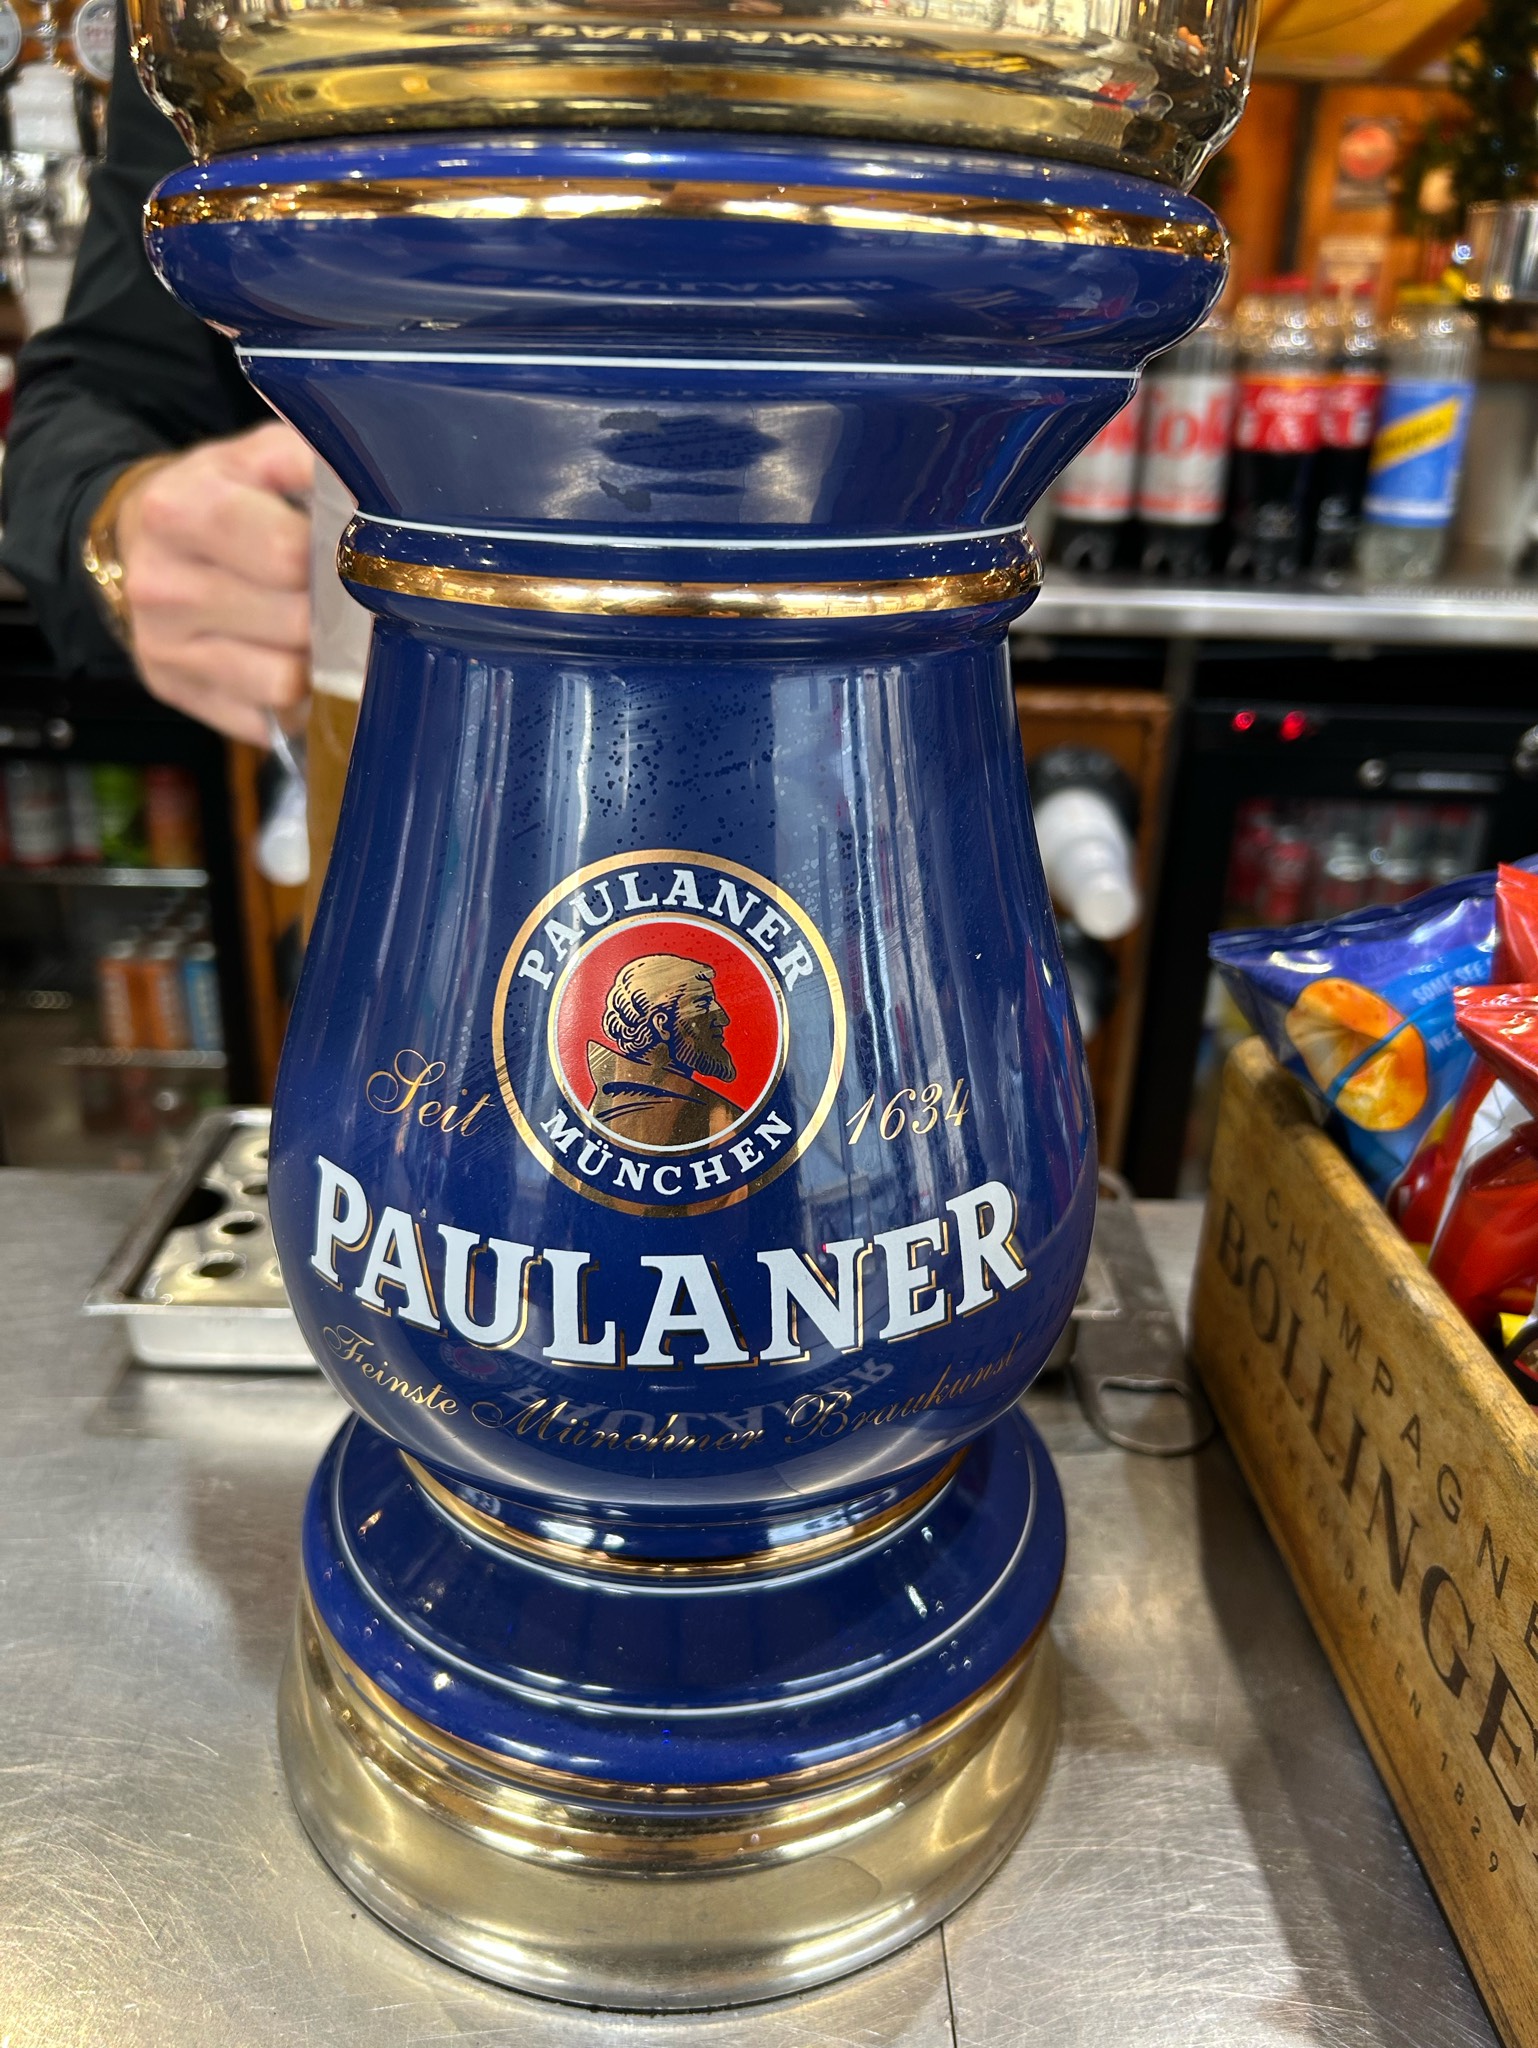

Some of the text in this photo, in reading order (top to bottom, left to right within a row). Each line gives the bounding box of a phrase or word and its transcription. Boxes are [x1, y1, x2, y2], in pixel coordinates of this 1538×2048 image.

[518, 869, 814, 992] PAULANER
[366, 1049, 969, 1145] Seit 1634
[540, 1108, 793, 1196] MÜNCHEN
[310, 1154, 1028, 1371] PAULANER
[322, 1324, 460, 1416] Feinste
[471, 1396, 766, 1454] Münchner
[784, 1331, 1023, 1446] Braukunst
[1218, 1197, 1538, 1865] BOLLINGE
[1440, 1751, 1499, 1873] 1829
